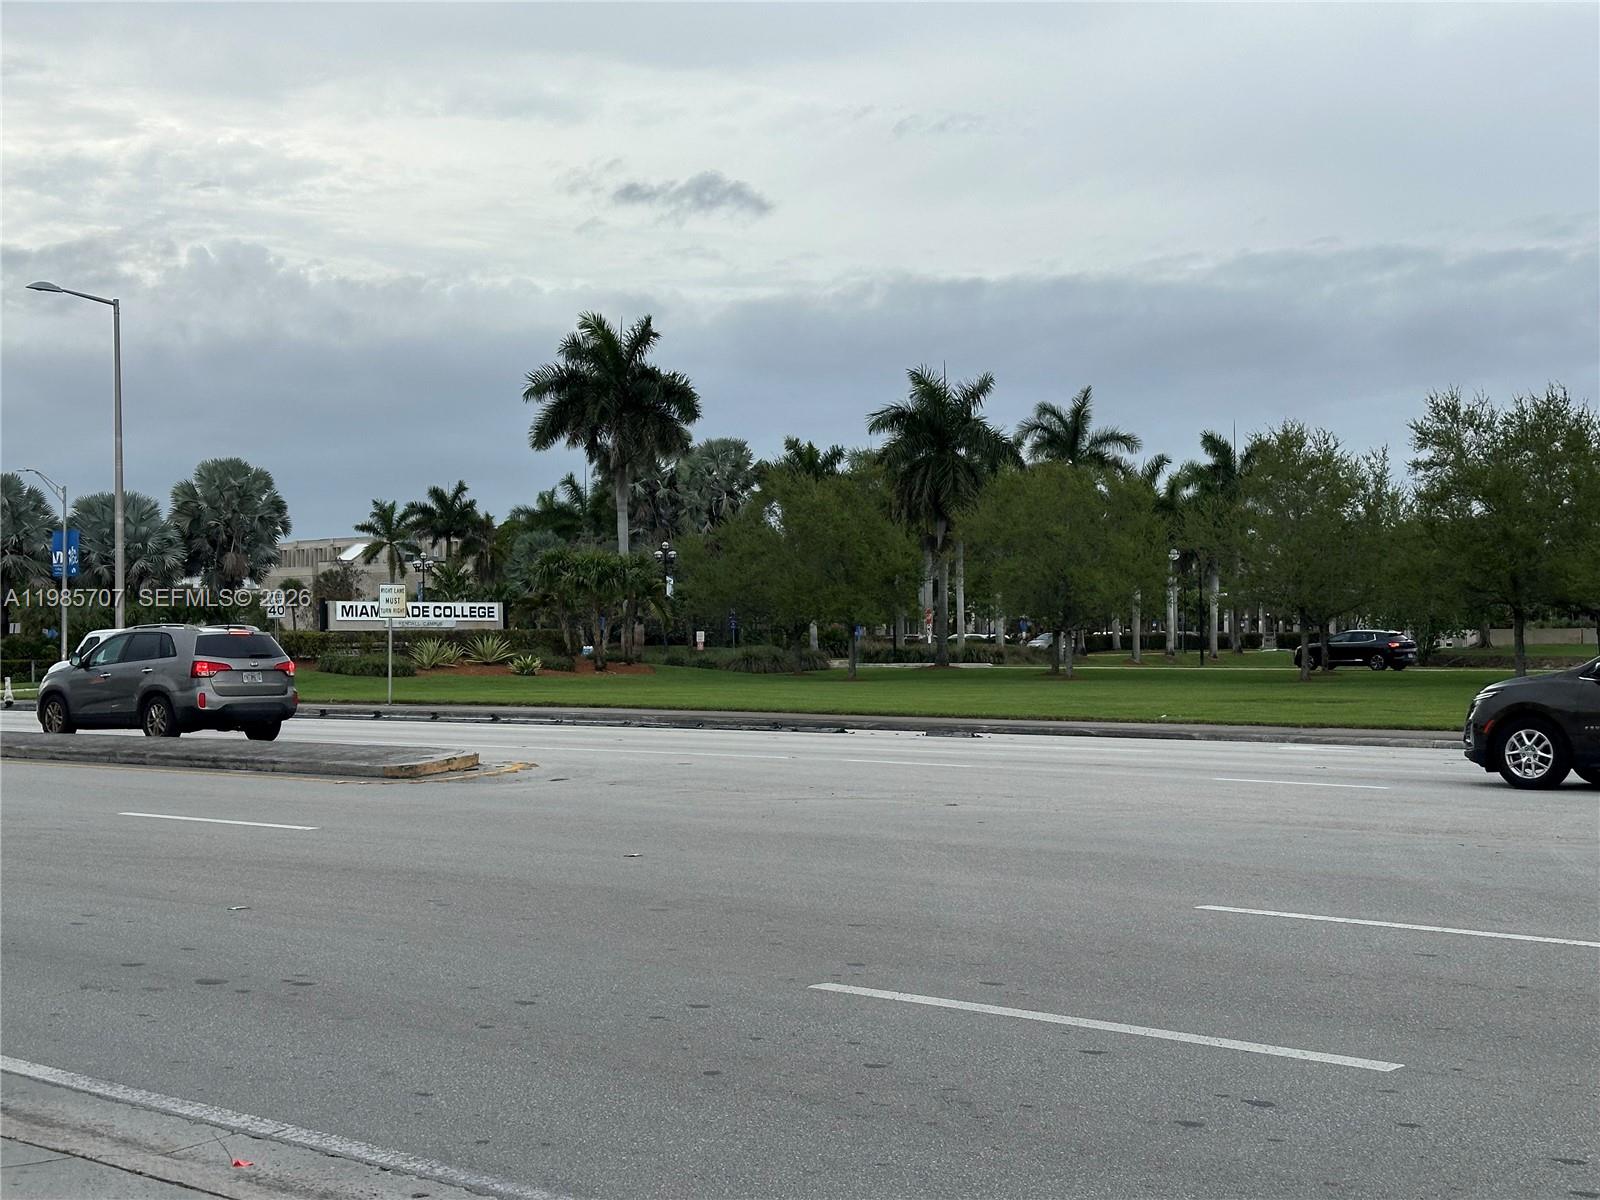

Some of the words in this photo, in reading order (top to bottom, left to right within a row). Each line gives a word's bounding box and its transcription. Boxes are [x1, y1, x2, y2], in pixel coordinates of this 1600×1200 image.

[268, 605, 285, 615] 40
[341, 605, 380, 618] MIAM
[433, 606, 495, 618] COLLEGE
